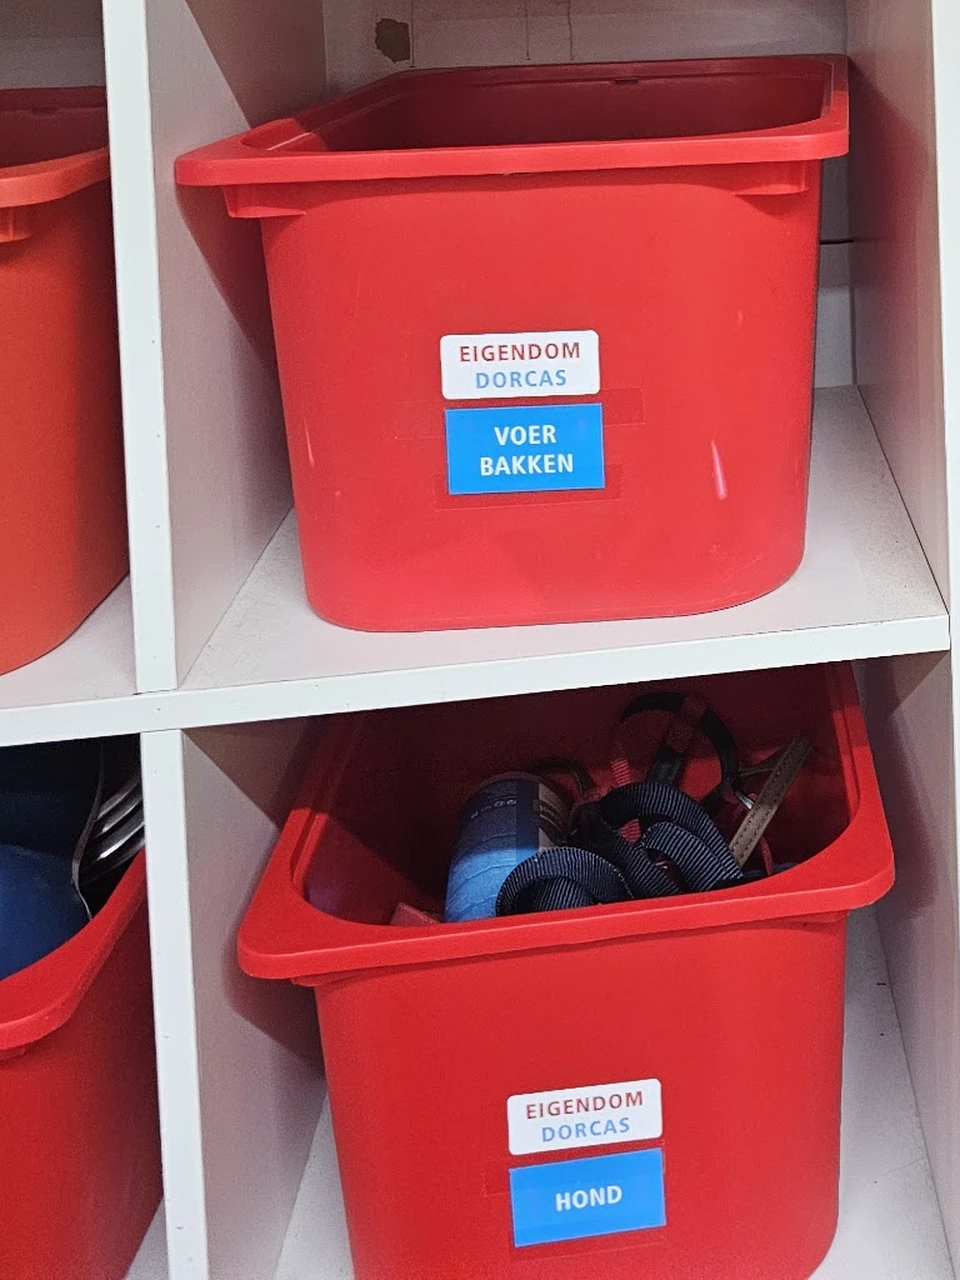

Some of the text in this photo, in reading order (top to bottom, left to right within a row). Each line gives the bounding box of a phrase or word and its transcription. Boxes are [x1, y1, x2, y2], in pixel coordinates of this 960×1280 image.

[459, 342, 581, 363] EIGENDOM
[476, 369, 567, 389] DORCAS
[493, 424, 557, 446] VOER
[480, 453, 574, 476] BAKKEN
[526, 1090, 644, 1120] EIGENDOM
[541, 1117, 630, 1142] DORCAS
[555, 1185, 623, 1212] HOND
